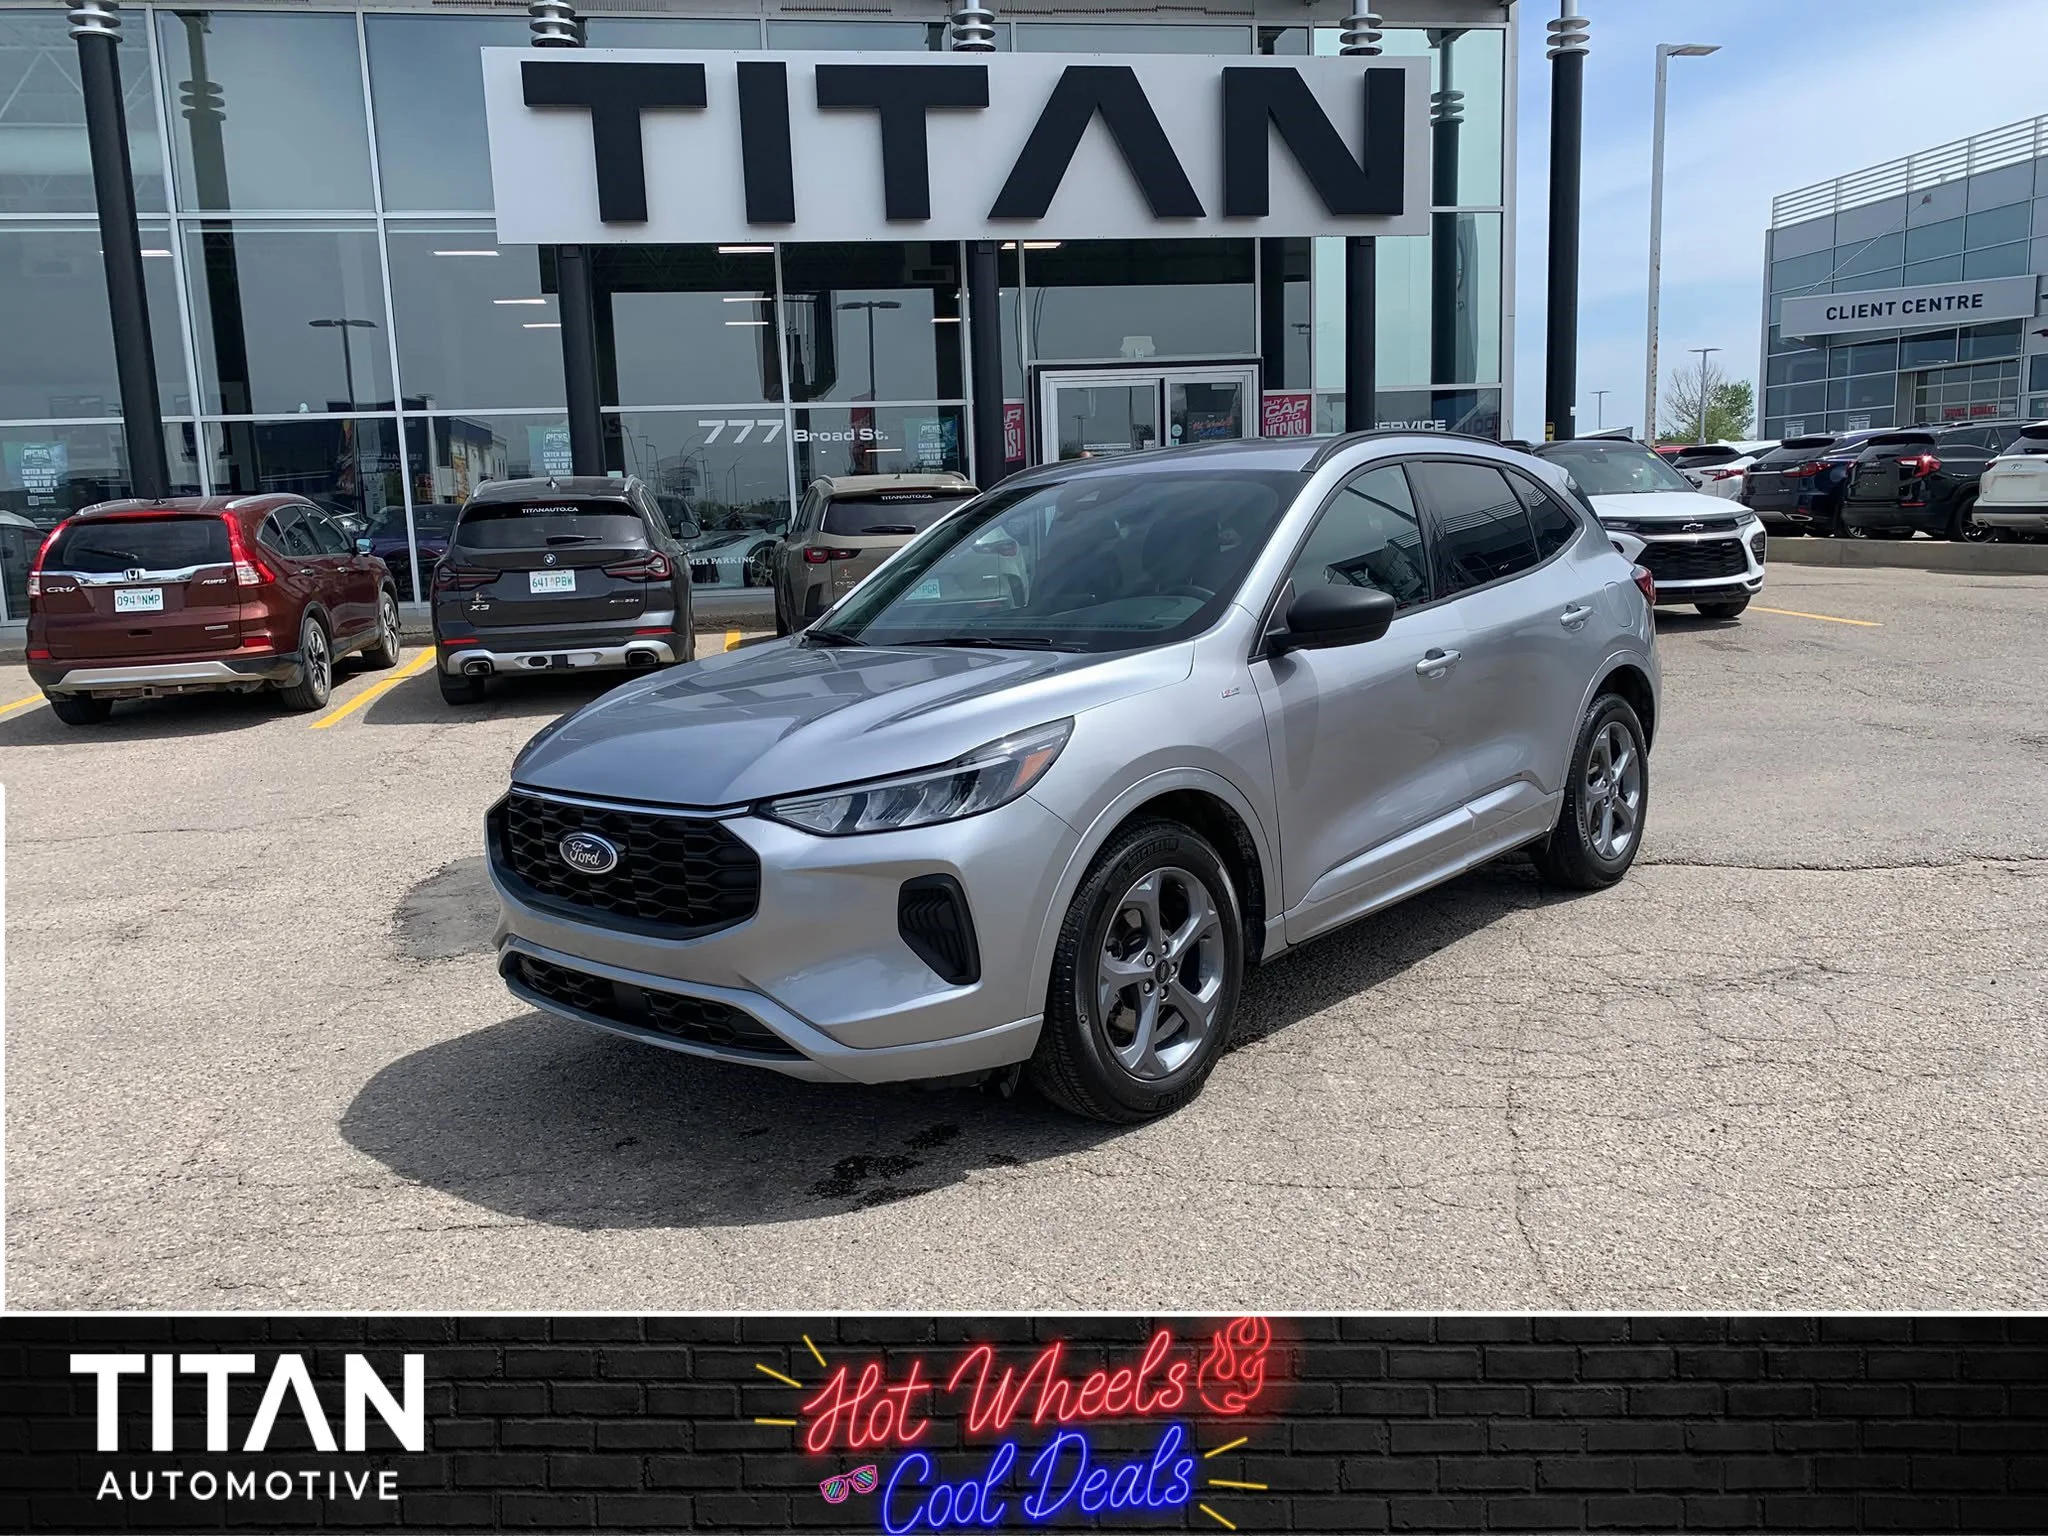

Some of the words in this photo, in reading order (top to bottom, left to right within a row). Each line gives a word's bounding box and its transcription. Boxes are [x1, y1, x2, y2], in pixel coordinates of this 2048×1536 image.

[520, 61, 1406, 223] TITAN
[1826, 301, 1896, 321] CLIENT
[1902, 293, 1983, 314] CENTRE
[1265, 400, 1308, 418] CAR
[1267, 416, 1284, 425] GO
[1286, 413, 1301, 421] TO
[698, 419, 784, 444] 777
[793, 429, 855, 443] Broad
[859, 428, 889, 441] St.
[521, 506, 579, 514] TITANAUTO.CA
[711, 556, 756, 564] PARKING
[532, 577, 549, 588] 641
[117, 596, 136, 606] 094
[141, 595, 161, 605] NMP
[570, 840, 601, 866] Ford
